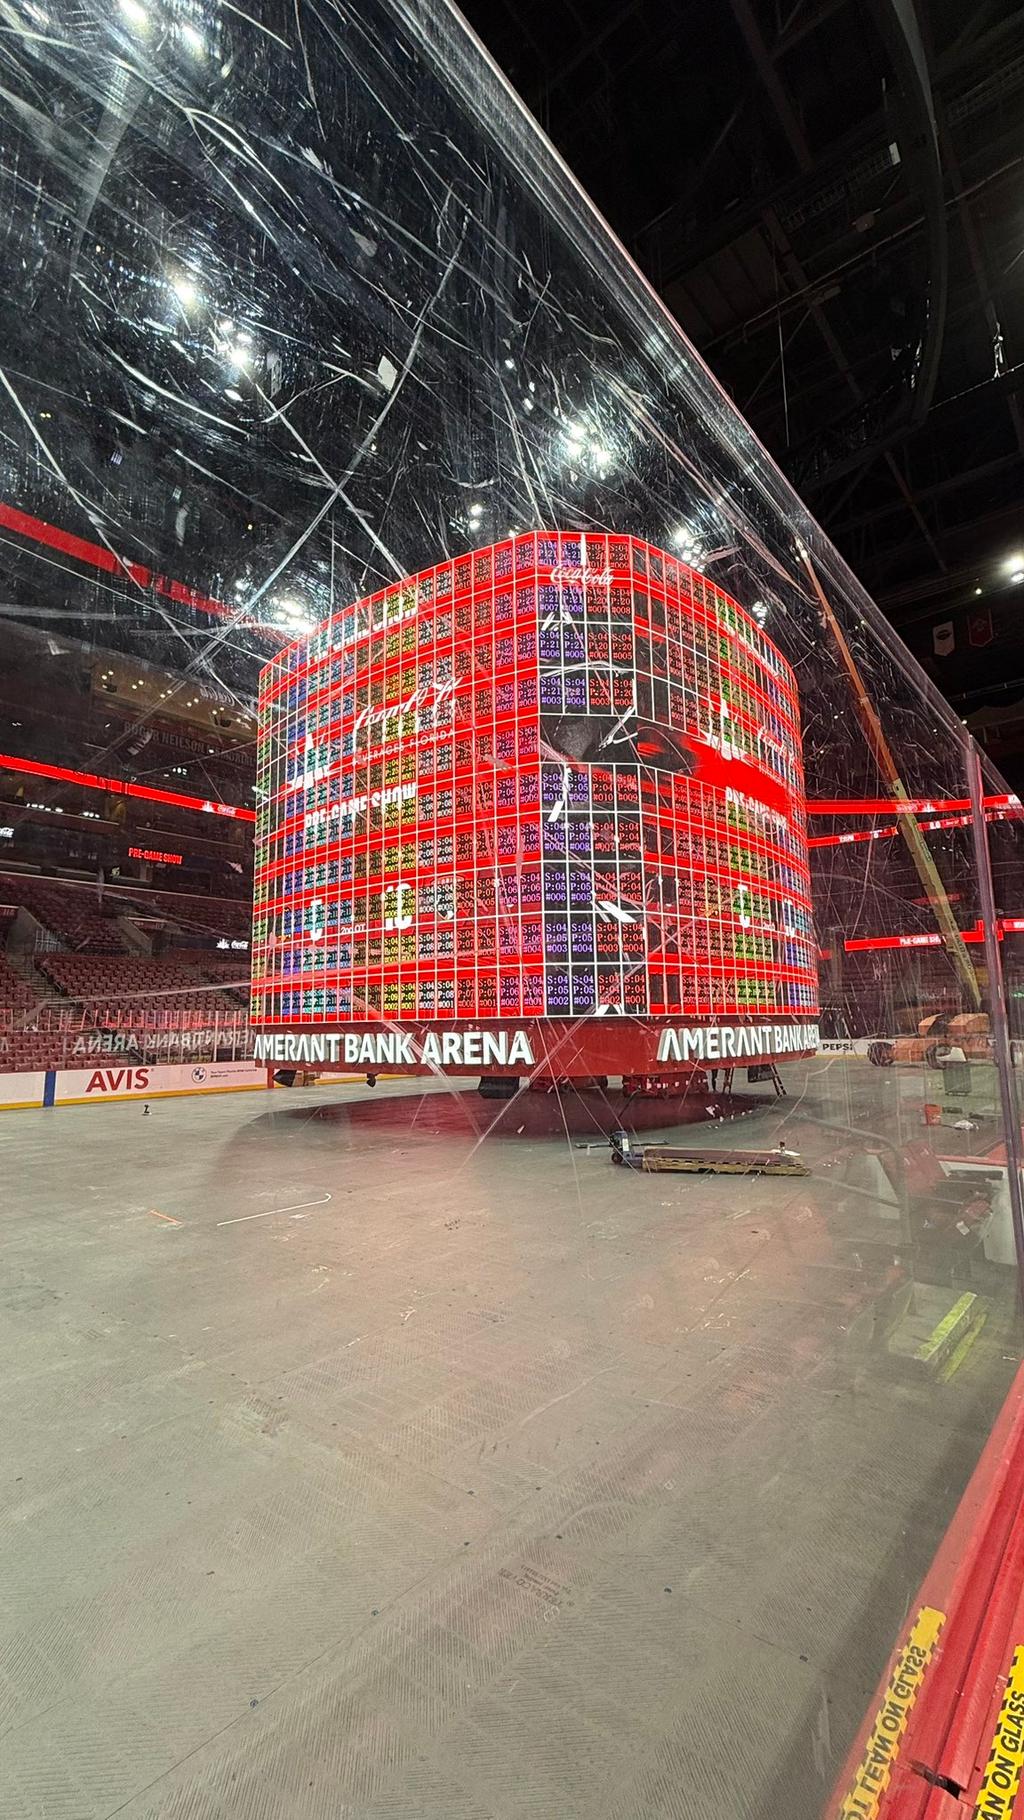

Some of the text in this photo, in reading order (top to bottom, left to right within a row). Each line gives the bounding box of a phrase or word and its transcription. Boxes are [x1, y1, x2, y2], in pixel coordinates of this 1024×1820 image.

[611, 589, 630, 597] S:04
[539, 594, 559, 602] P:21
[611, 598, 631, 606] P:20
[539, 604, 560, 612] #007
[612, 643, 632, 651] P:20
[565, 650, 585, 658] #005
[613, 652, 633, 660] #005
[518, 678, 536, 690] S:04
[565, 678, 585, 686] S:04
[518, 687, 536, 699] P:22
[497, 739, 515, 751] P:22
[437, 789, 452, 800] S:04
[497, 787, 515, 798] P:06
[437, 808, 453, 819] #009
[543, 823, 564, 831] S:04
[569, 823, 589, 831] S:04
[618, 823, 639, 832] S:04
[619, 833, 640, 842] P:04
[570, 843, 590, 851] #008
[521, 873, 540, 884] S:04
[544, 873, 565, 881] S:04
[570, 873, 590, 881] S:04
[521, 883, 540, 894] P:06
[545, 883, 566, 891] P:05
[570, 883, 591, 891] P:05
[621, 883, 641, 891] P:04
[521, 894, 541, 904] #005
[545, 893, 567, 901] #006
[571, 893, 592, 901] #005
[522, 924, 541, 934] S:04
[546, 923, 566, 932] S:04
[571, 923, 592, 932] S:04
[596, 923, 618, 932] S:04
[622, 923, 643, 932] S:04
[522, 934, 542, 944] P:06
[546, 934, 567, 942] P:05
[572, 934, 592, 942] P:05
[623, 934, 643, 942] P:04
[547, 944, 568, 953] #003
[572, 944, 594, 952] #004
[598, 944, 619, 952] #003
[623, 944, 644, 952] #004
[478, 978, 496, 987] S:04
[500, 977, 519, 986] S:04
[547, 975, 568, 985] S:04
[573, 975, 594, 984] S:04
[624, 975, 644, 984] S:04
[419, 982, 434, 991] S:04
[438, 981, 454, 989] S:04
[478, 988, 496, 997] P:07
[500, 988, 519, 996] P:06
[548, 986, 568, 996] P:05
[573, 986, 594, 994] P:05
[625, 986, 645, 994] P:04
[438, 1000, 455, 1009] #001
[501, 998, 520, 1007] #002
[548, 997, 570, 1006] #002
[574, 996, 595, 1005] #001
[625, 996, 646, 1005] #001
[254, 1030, 536, 1065] AMERANT BANK ARENA
[657, 1026, 772, 1061] AMERANT
[774, 1025, 803, 1053] BANK
[86, 1068, 150, 1093] AVIS
[1001, 1690, 1024, 1753] GLASS
[992, 1756, 1016, 1790] ON
